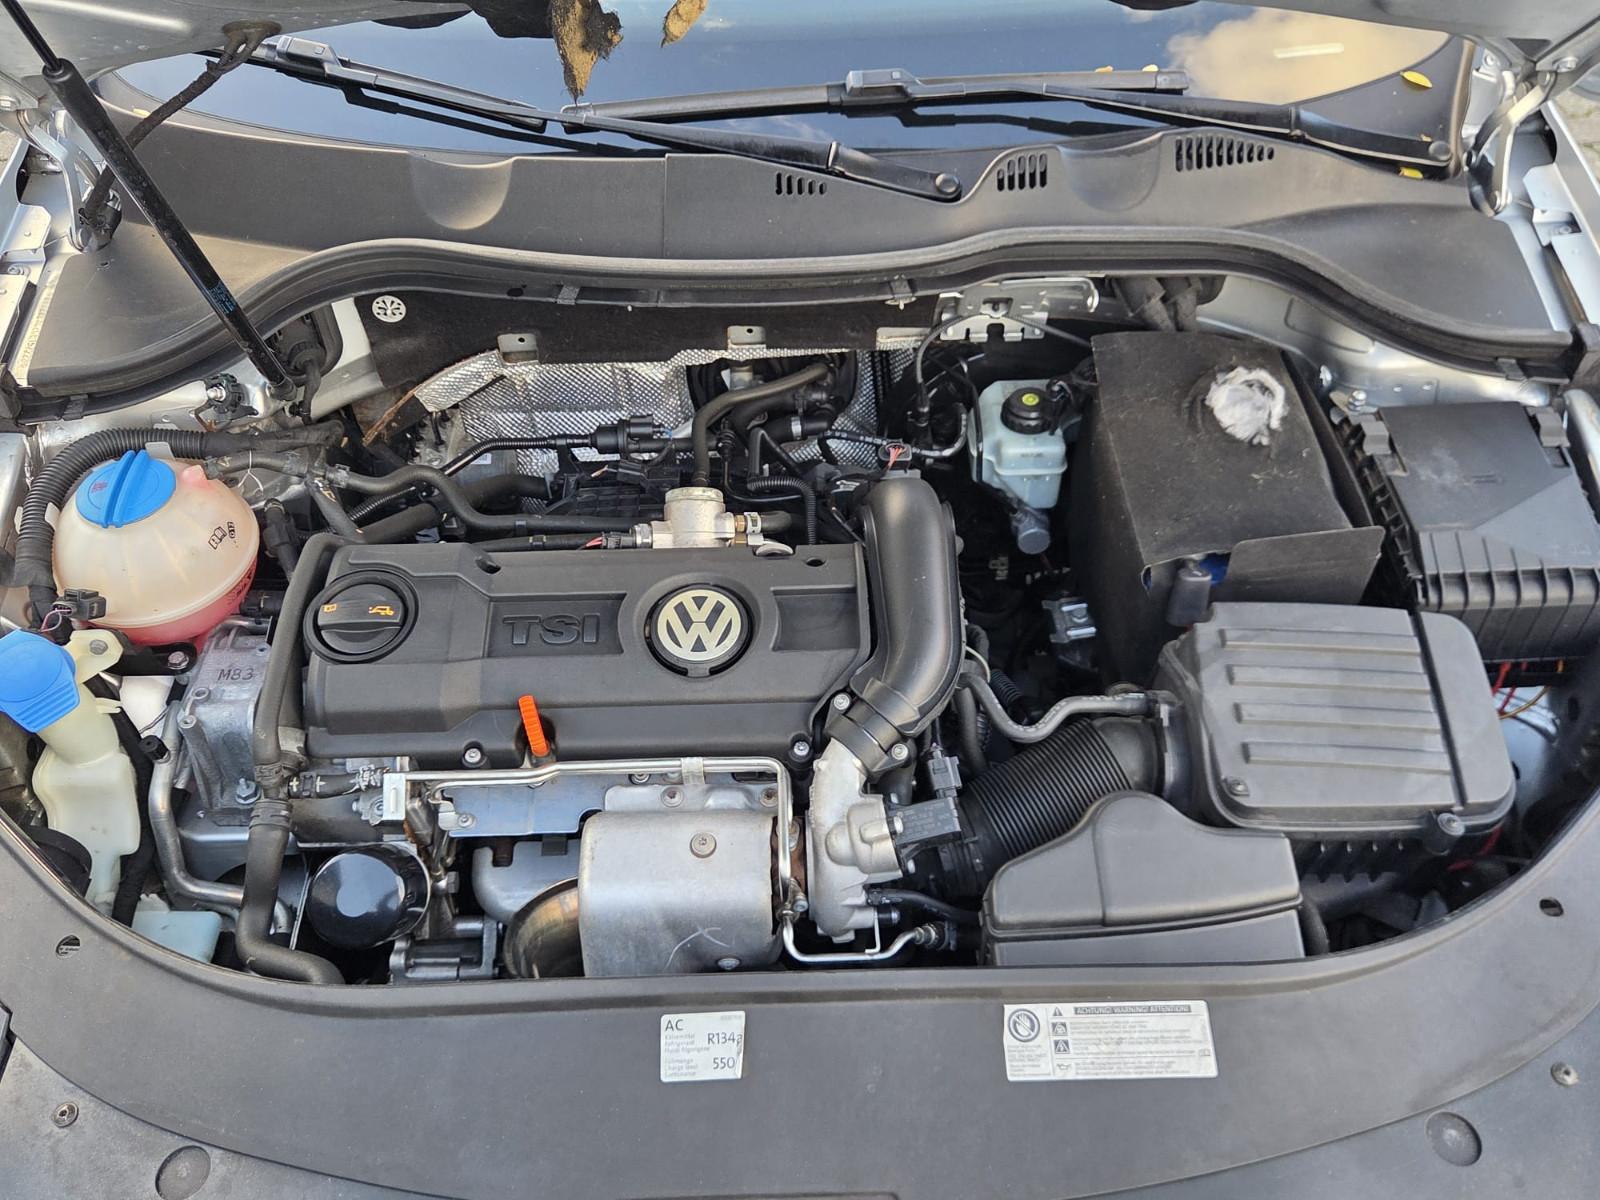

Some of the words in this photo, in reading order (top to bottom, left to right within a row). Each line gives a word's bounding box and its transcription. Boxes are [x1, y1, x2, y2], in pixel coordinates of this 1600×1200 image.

[503, 614, 599, 645] TSI
[218, 668, 254, 681] M83
[665, 1019, 684, 1031] AC
[713, 1056, 736, 1070] 550
